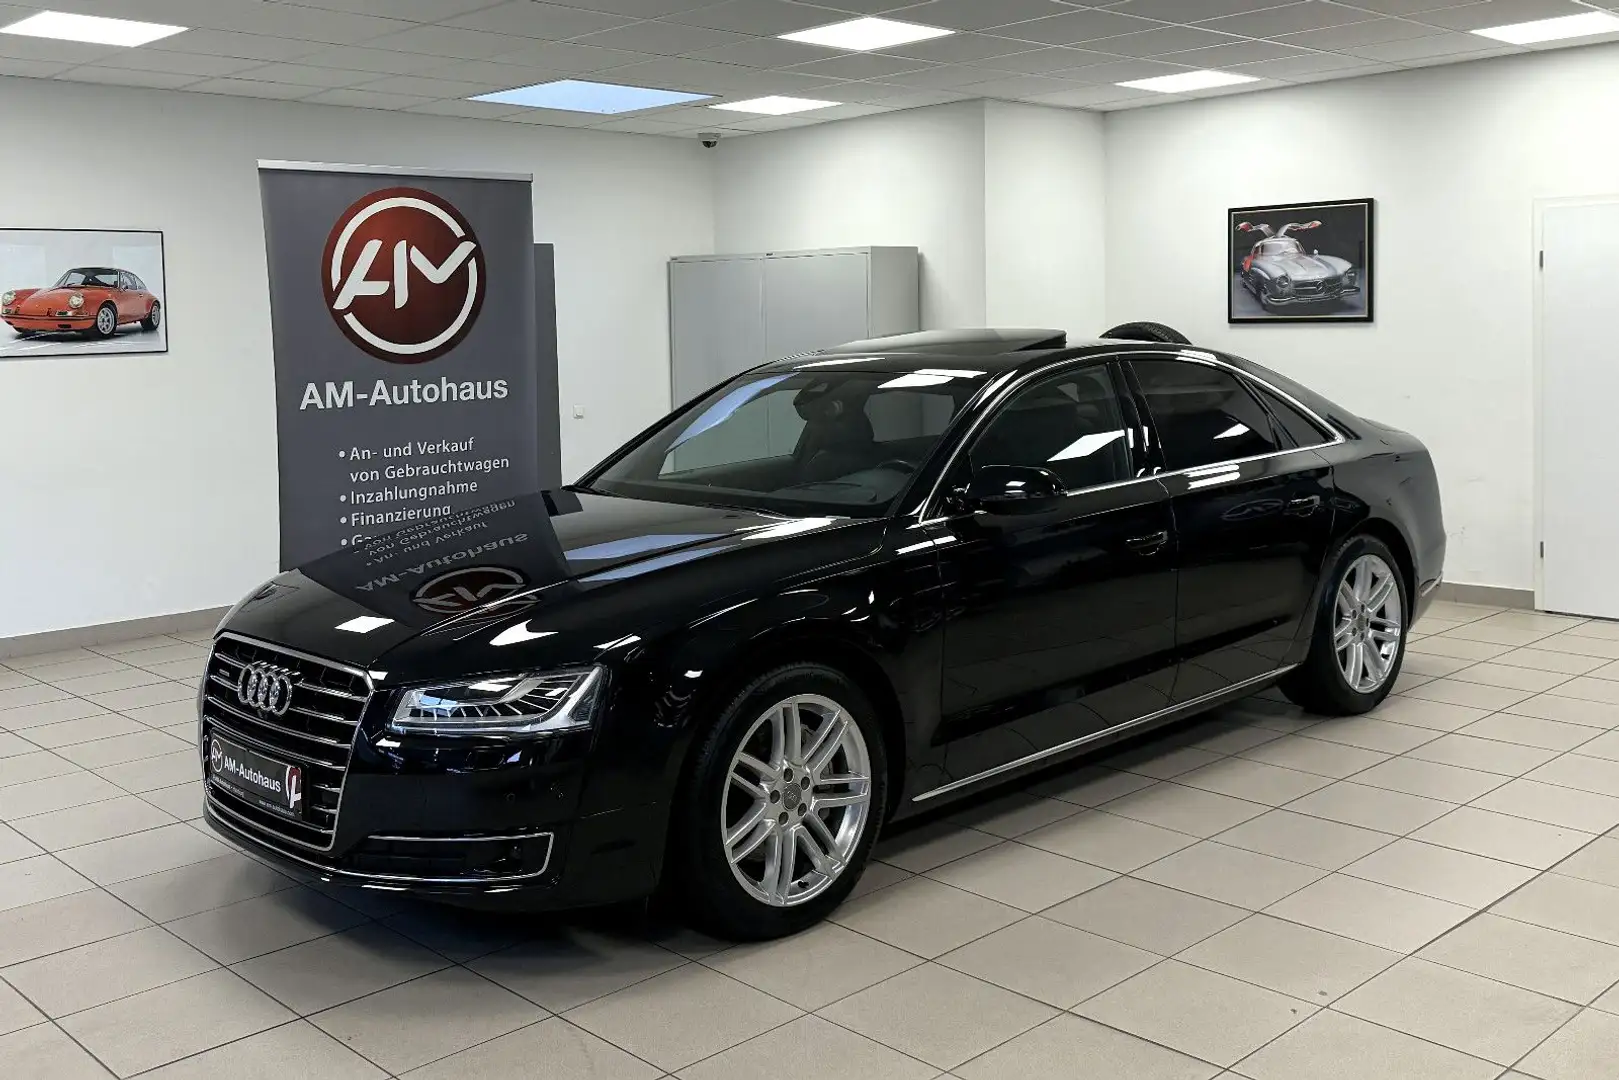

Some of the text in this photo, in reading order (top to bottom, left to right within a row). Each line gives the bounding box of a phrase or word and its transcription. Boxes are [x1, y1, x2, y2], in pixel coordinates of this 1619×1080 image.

[332, 238, 477, 311] AM
[299, 376, 509, 411] AM-Autohaus
[349, 436, 475, 461] An- und Verkauf
[349, 456, 510, 483] von Gebrauchtwagen
[350, 479, 478, 505] Inzahlungnahme
[224, 755, 282, 793] AM-Autohaus
